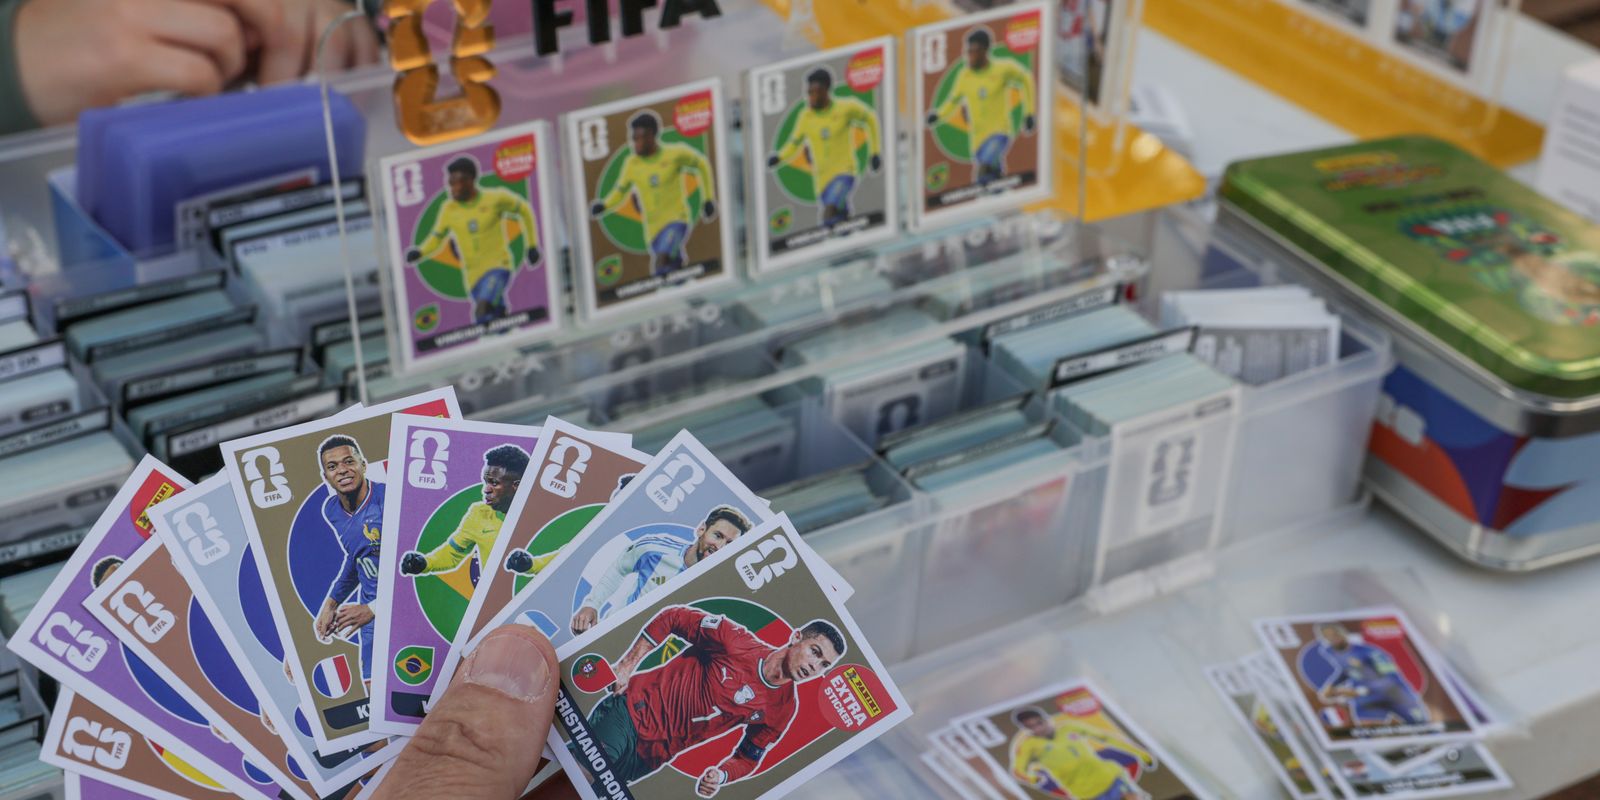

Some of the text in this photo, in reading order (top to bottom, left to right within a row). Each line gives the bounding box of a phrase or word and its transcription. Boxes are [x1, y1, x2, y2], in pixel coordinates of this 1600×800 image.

[418, 476, 436, 485] FIFA
[549, 480, 567, 493] FIFA
[264, 493, 282, 502] FIFA
[653, 489, 669, 506] FIFA
[203, 546, 222, 560] FIFA
[742, 564, 756, 582] FIFA
[151, 619, 169, 635] FIFA
[85, 646, 100, 663] FIFA
[830, 674, 867, 726] EXTRA
[855, 680, 880, 715] PANINI
[824, 686, 853, 728] STICKER
